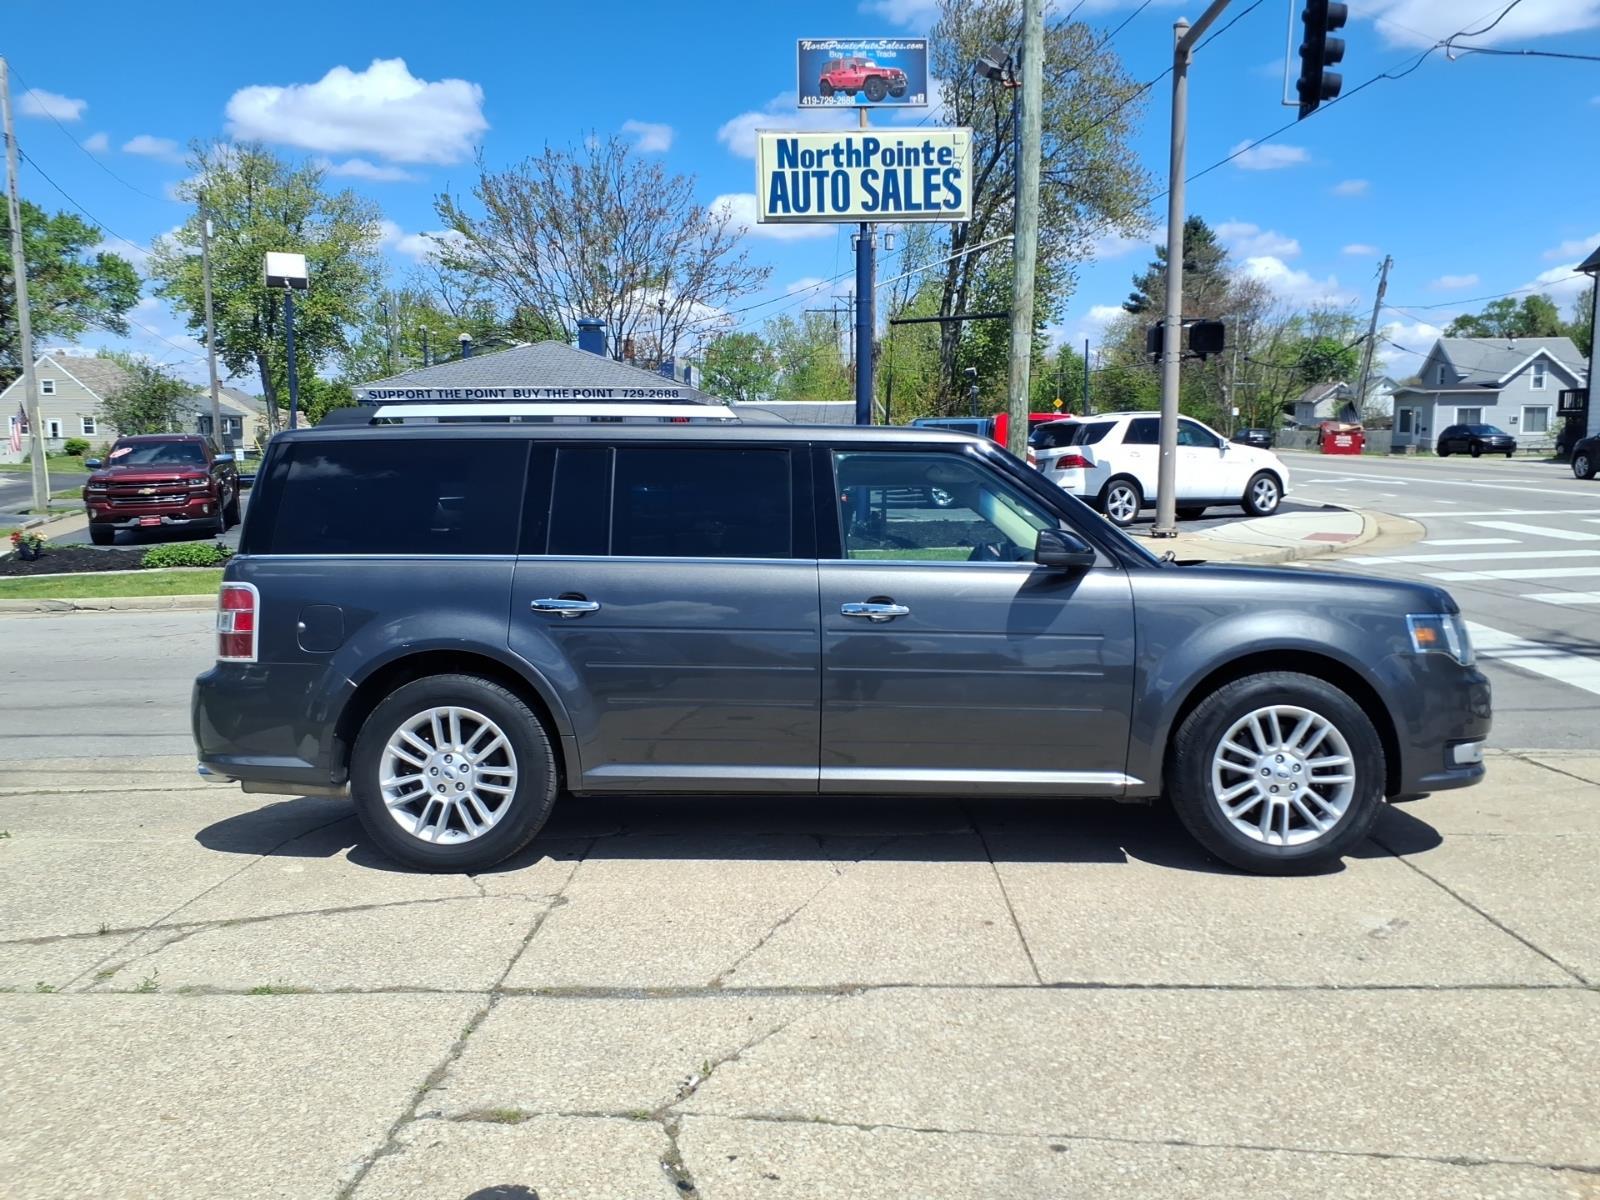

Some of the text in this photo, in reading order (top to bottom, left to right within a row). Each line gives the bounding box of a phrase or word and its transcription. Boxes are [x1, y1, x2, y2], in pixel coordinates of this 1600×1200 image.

[801, 40, 924, 50] NorthPointeAutoSales.com
[829, 50, 843, 59] Buy
[853, 50, 867, 58] Sell
[876, 50, 896, 58] Trade
[776, 137, 952, 169] NorthPointe
[768, 167, 962, 214] AUTO SALES
[368, 389, 679, 399] SUPPORT THE POINT BUY THE POINT 729-2688
